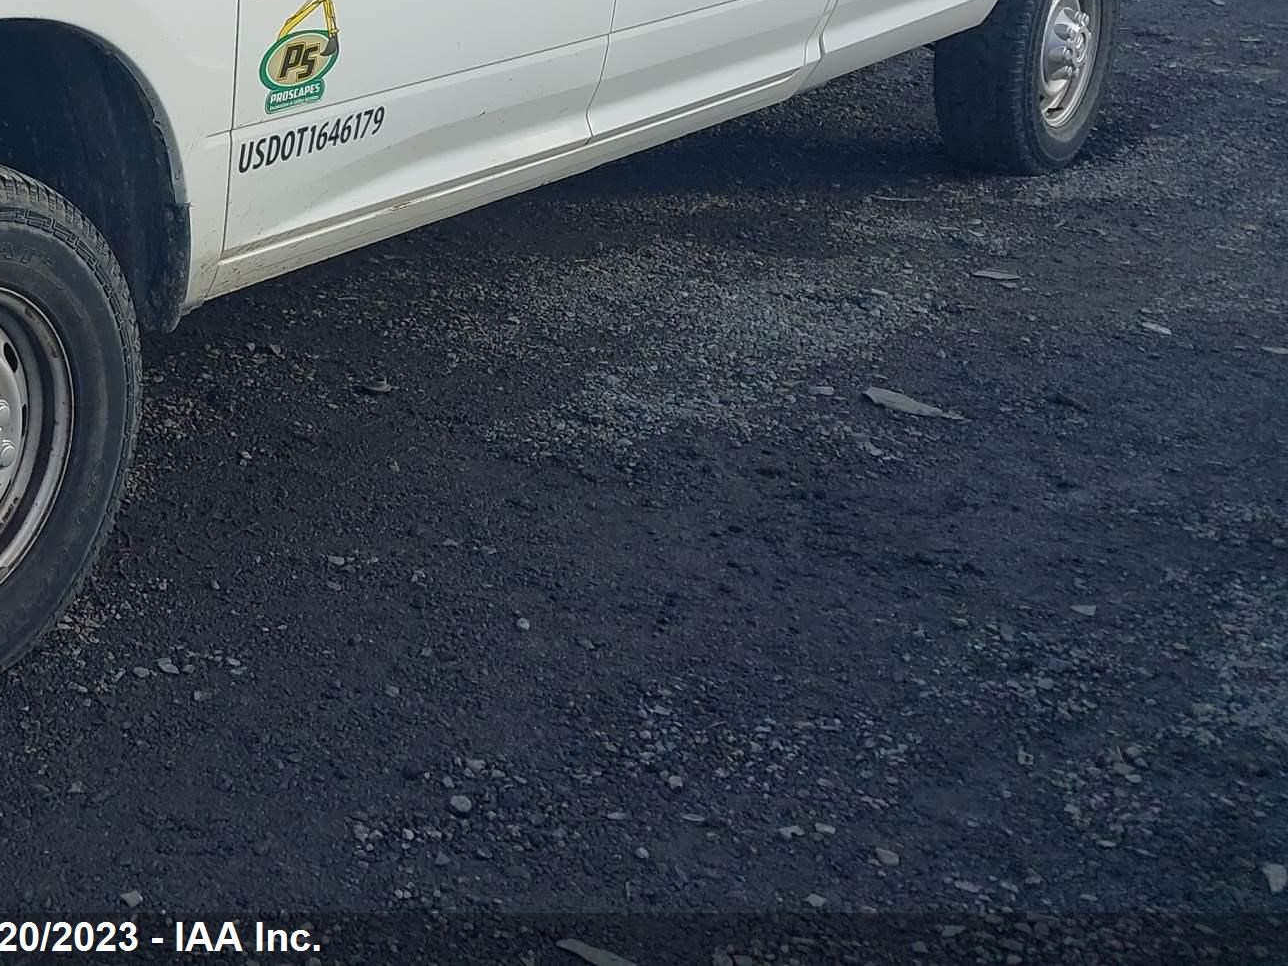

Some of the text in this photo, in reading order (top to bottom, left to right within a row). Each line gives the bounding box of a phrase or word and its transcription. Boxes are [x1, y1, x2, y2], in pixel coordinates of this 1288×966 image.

[277, 40, 322, 82] PS
[270, 82, 321, 105] PROSCAPES
[238, 105, 385, 174] USDOT1646179
